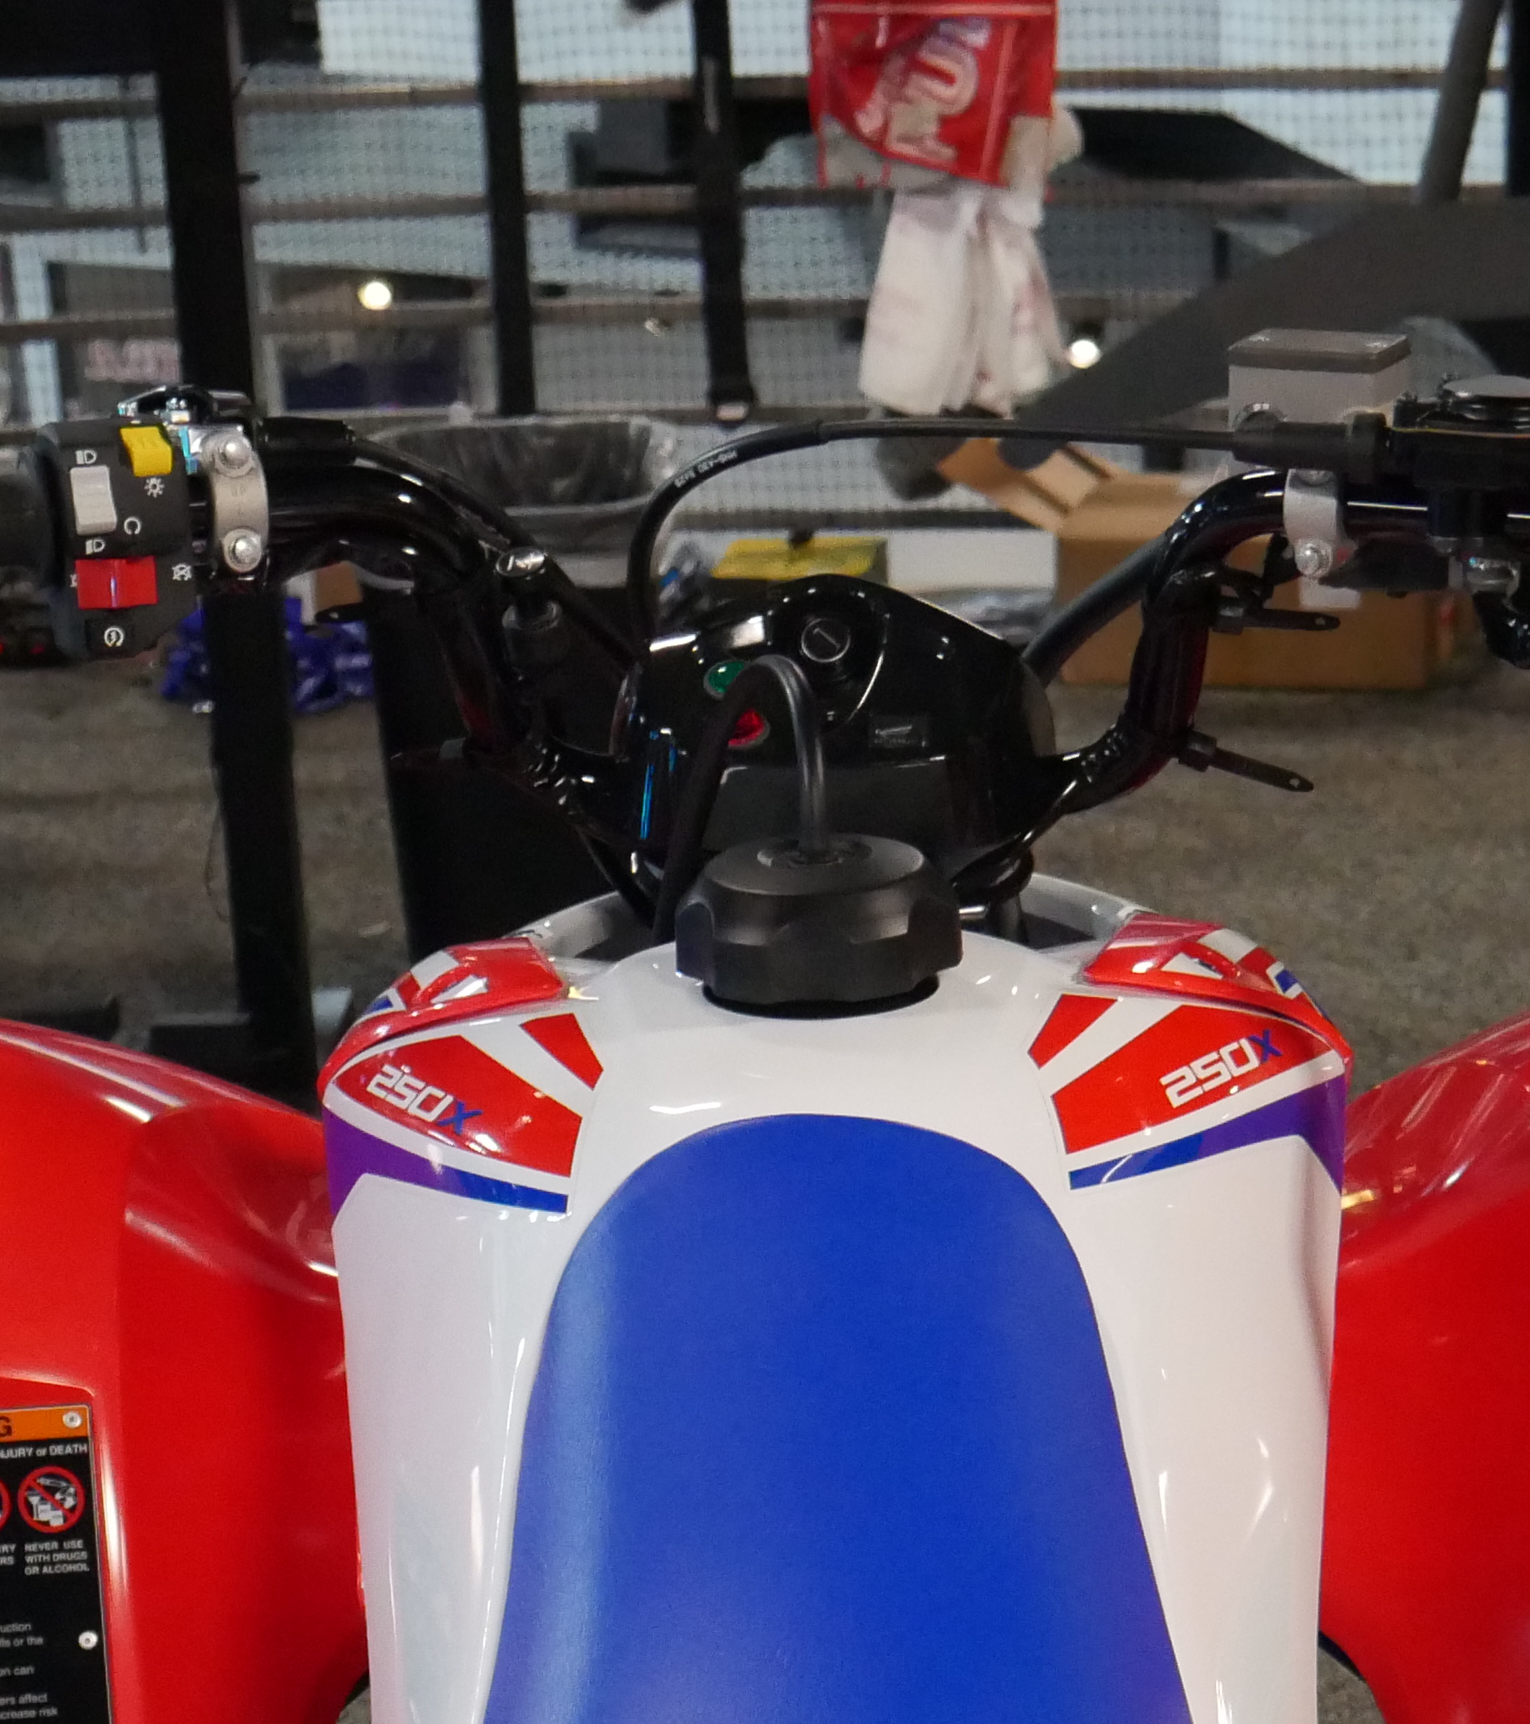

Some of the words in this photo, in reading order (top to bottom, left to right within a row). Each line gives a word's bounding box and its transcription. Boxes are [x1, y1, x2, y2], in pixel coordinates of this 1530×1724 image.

[1159, 1029, 1283, 1109] 250X
[365, 1064, 484, 1136] 250X
[36, 1447, 47, 1457] or
[49, 1444, 88, 1455] DEATH
[24, 1541, 59, 1552] NEVER
[63, 1539, 84, 1549] USE
[24, 1553, 50, 1563] WITH
[52, 1551, 88, 1561] DRUGS
[24, 1566, 39, 1575] OR
[42, 1562, 90, 1574] ALCOHOL
